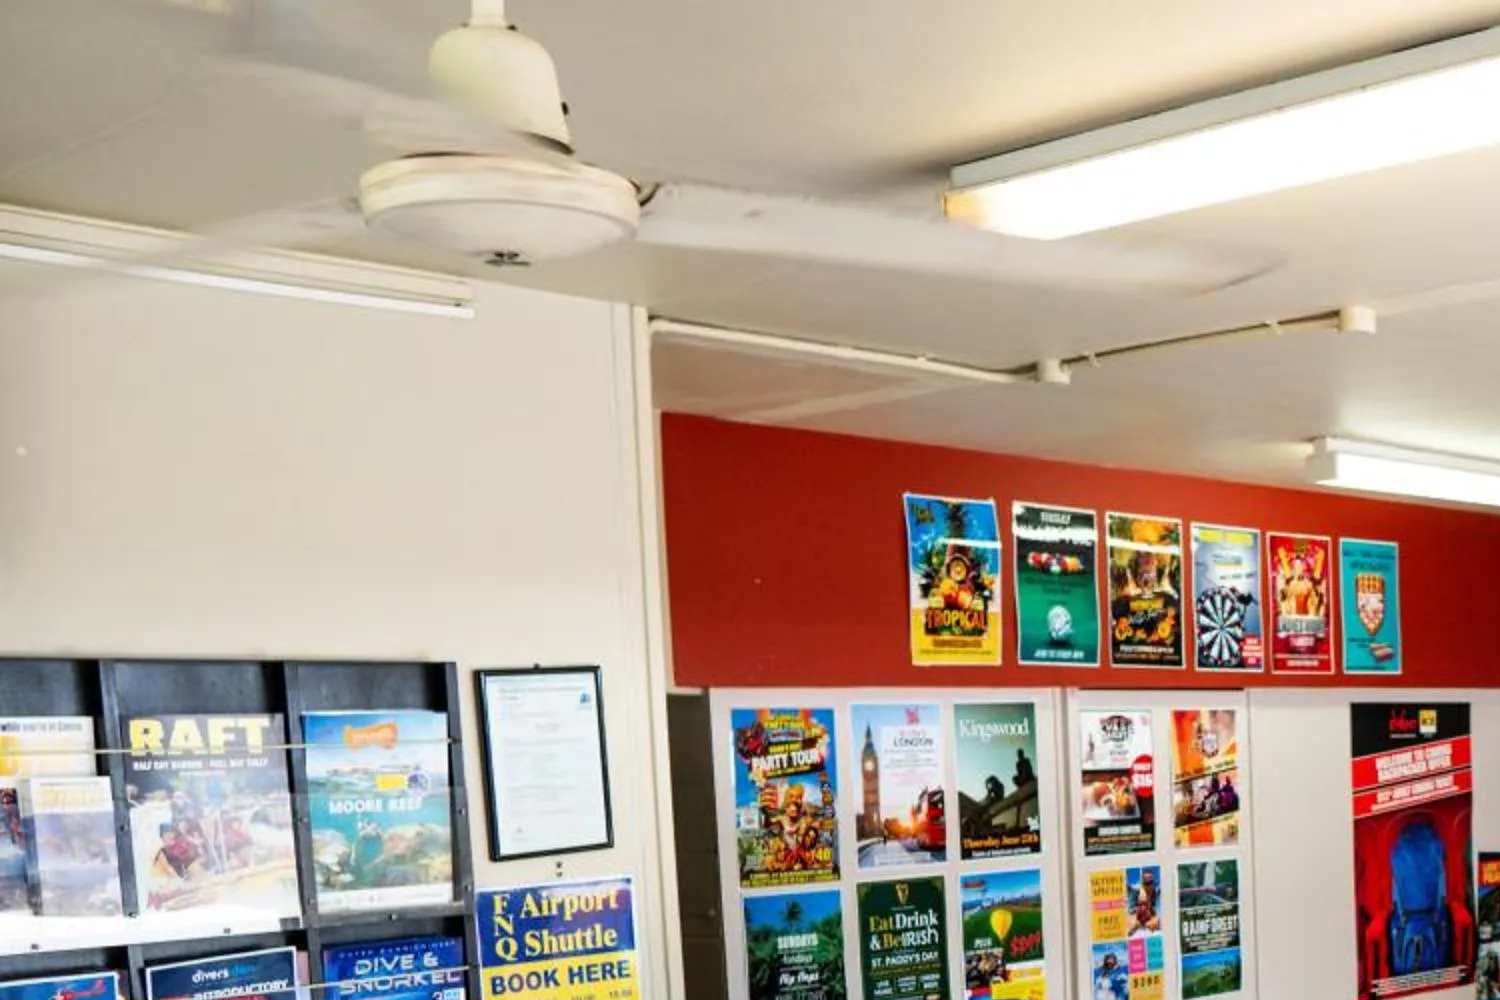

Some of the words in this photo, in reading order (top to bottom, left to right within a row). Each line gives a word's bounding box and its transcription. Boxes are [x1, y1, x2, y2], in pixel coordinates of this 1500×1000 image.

[927, 608, 986, 630] TROPICAL
[129, 716, 270, 757] RAFT
[893, 737, 934, 748] LONDON
[960, 718, 1030, 743] Kingswood
[751, 754, 789, 771] PARTY
[792, 751, 819, 765] TOUR
[520, 888, 620, 921] Airport
[895, 908, 939, 929] Drink
[524, 923, 618, 957] Shuttle
[192, 968, 229, 983] divers
[355, 953, 416, 976] DIVE
[423, 952, 439, 967] &
[338, 971, 463, 995] SNORKEL
[491, 967, 560, 995] BOOK
[567, 960, 632, 985] HERE
